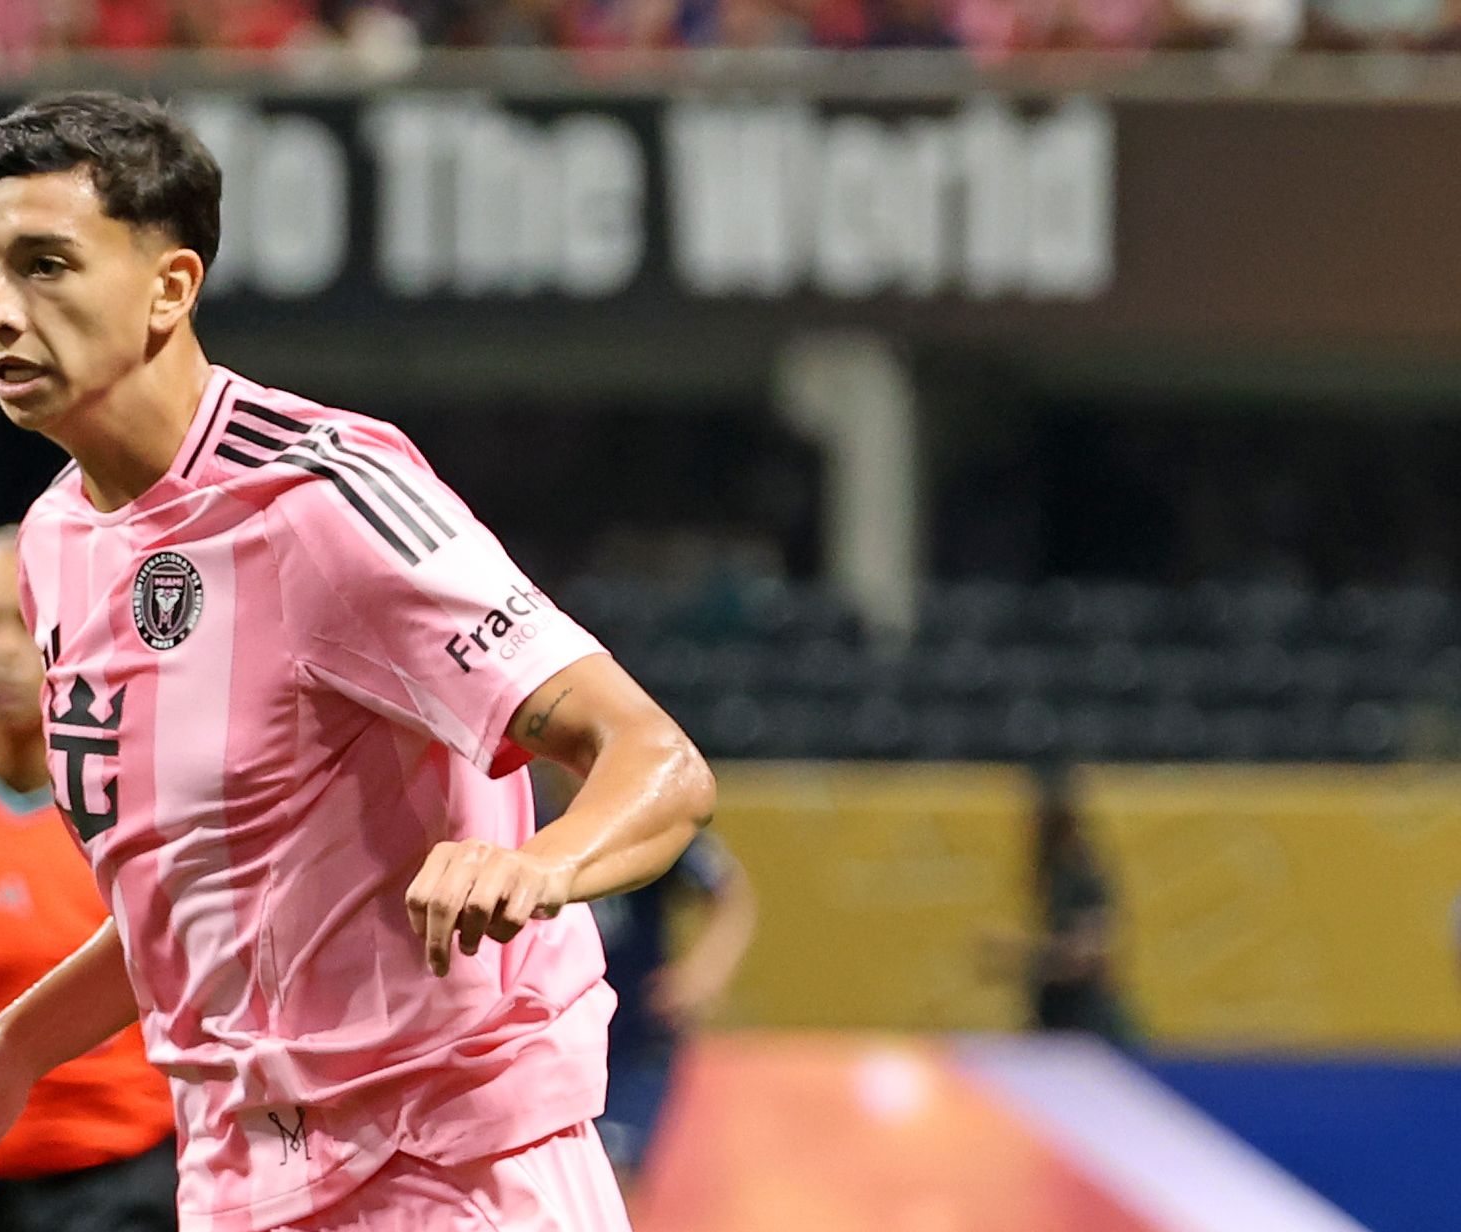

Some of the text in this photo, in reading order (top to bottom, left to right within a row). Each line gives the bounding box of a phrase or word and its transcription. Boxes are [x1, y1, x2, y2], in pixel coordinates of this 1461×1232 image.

[358, 92, 650, 300] The
[666, 90, 1118, 302] World
[444, 583, 548, 675] Frach
